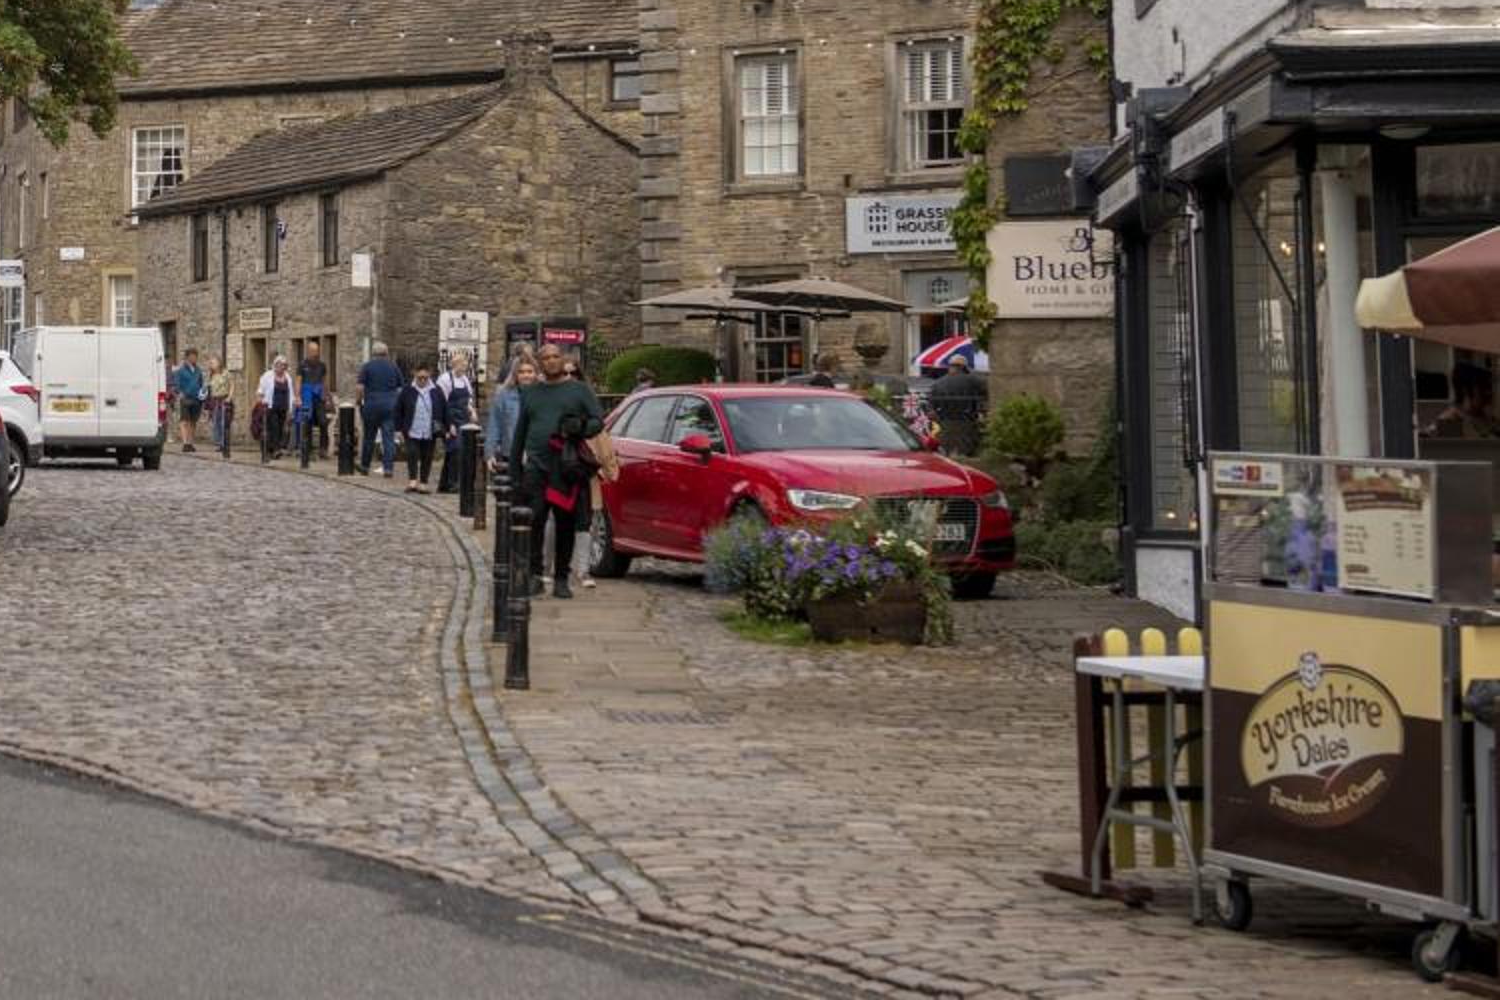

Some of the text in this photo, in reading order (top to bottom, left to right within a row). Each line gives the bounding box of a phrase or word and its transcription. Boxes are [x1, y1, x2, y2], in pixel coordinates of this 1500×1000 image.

[896, 221, 946, 233] HOUSE
[1025, 284, 1069, 295] HOME
[1075, 284, 1087, 294] &
[1292, 733, 1350, 768] Dales
